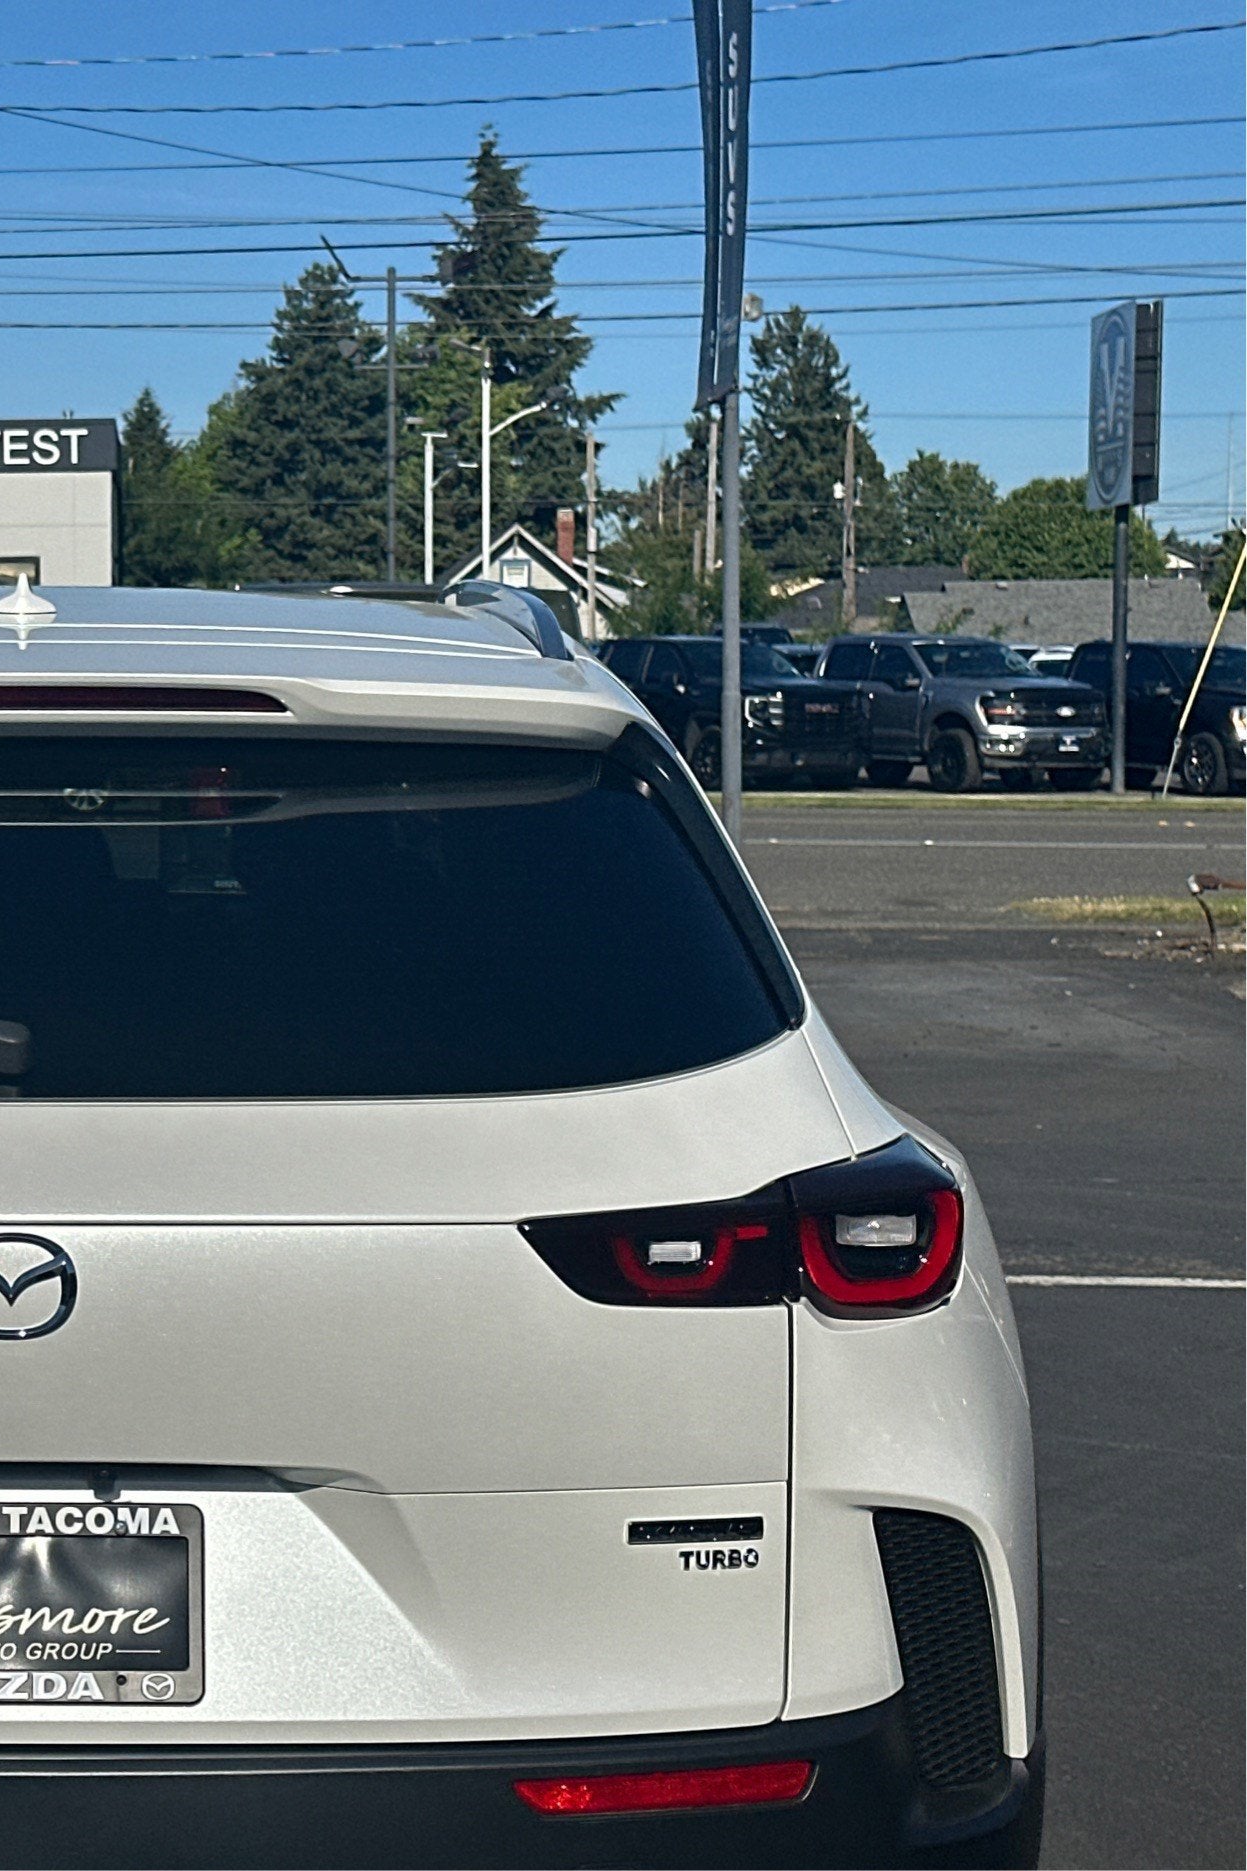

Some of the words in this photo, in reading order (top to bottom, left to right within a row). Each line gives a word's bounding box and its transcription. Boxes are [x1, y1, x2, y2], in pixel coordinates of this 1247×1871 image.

[726, 31, 739, 237] SUVS
[2, 1505, 181, 1535] TACOMA
[678, 1547, 760, 1572] TURBO
[25, 1641, 113, 1661] GROUP
